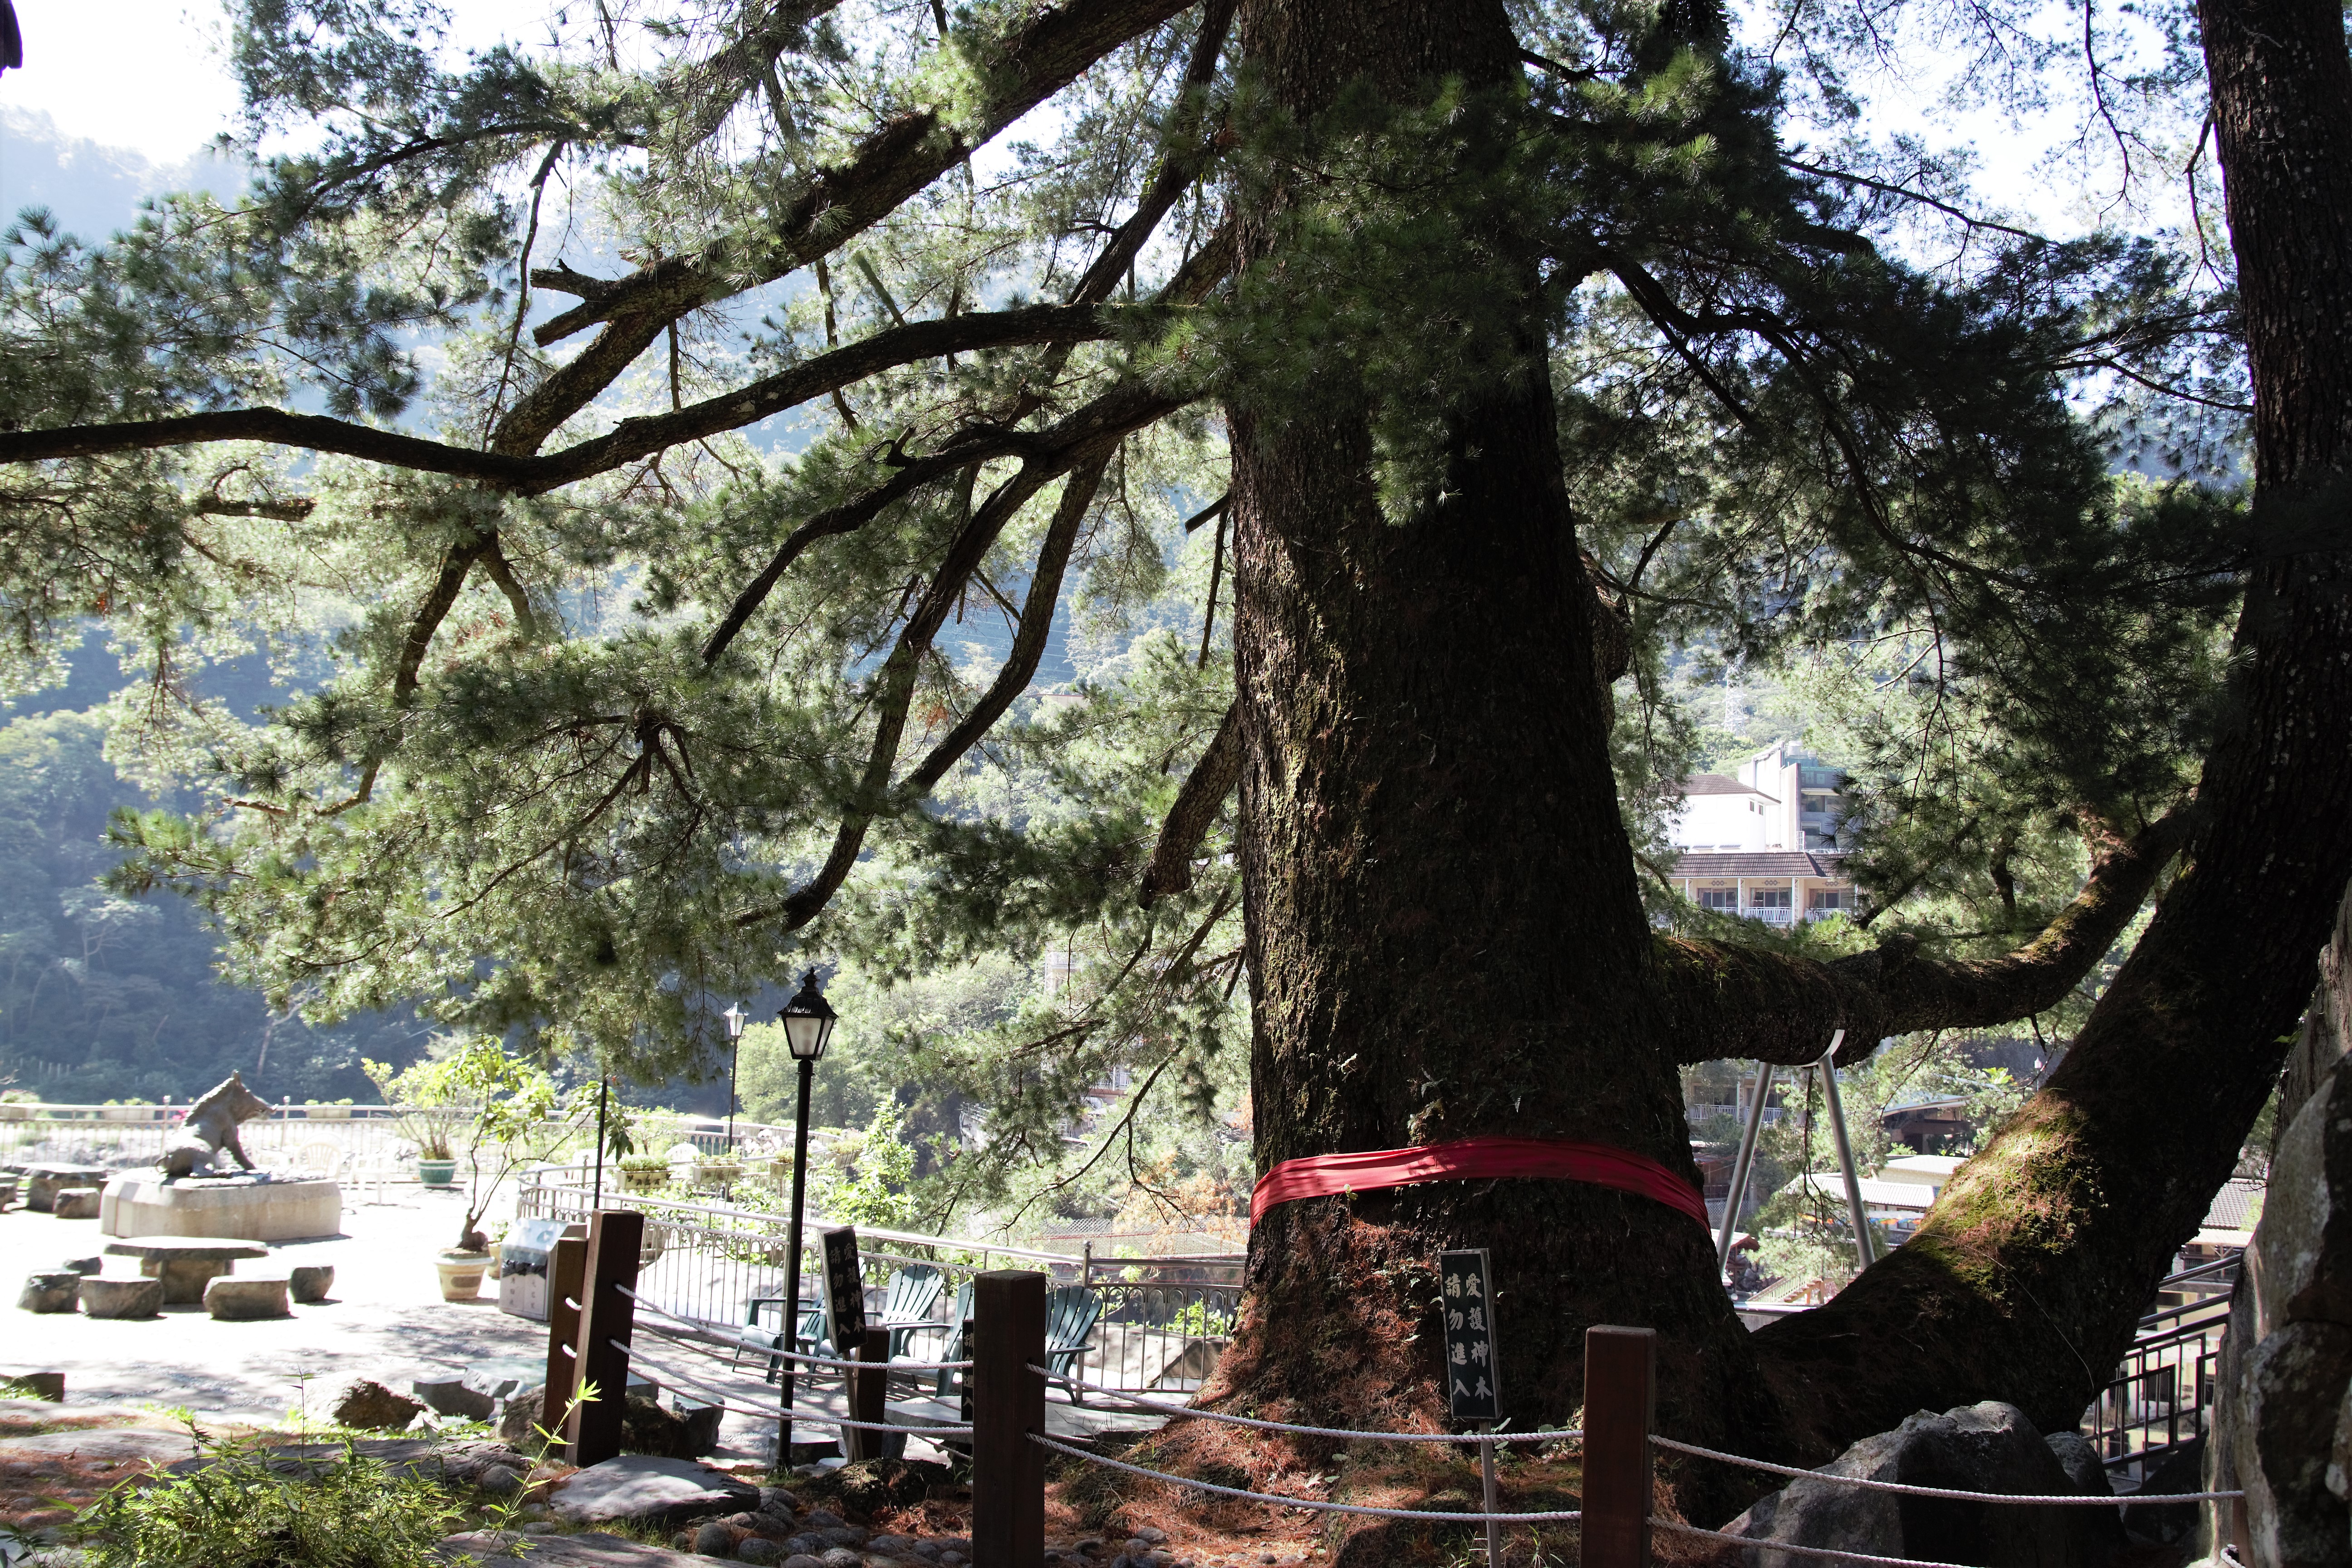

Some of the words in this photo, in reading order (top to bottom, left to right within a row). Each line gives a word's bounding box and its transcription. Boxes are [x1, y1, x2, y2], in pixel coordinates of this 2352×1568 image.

[829, 1246, 850, 1336] 請勿進入
[844, 1243, 865, 1333] 愛護神木
[1445, 1273, 1470, 1397] 請勿進入
[1465, 1273, 1493, 1400] 愛護神木
